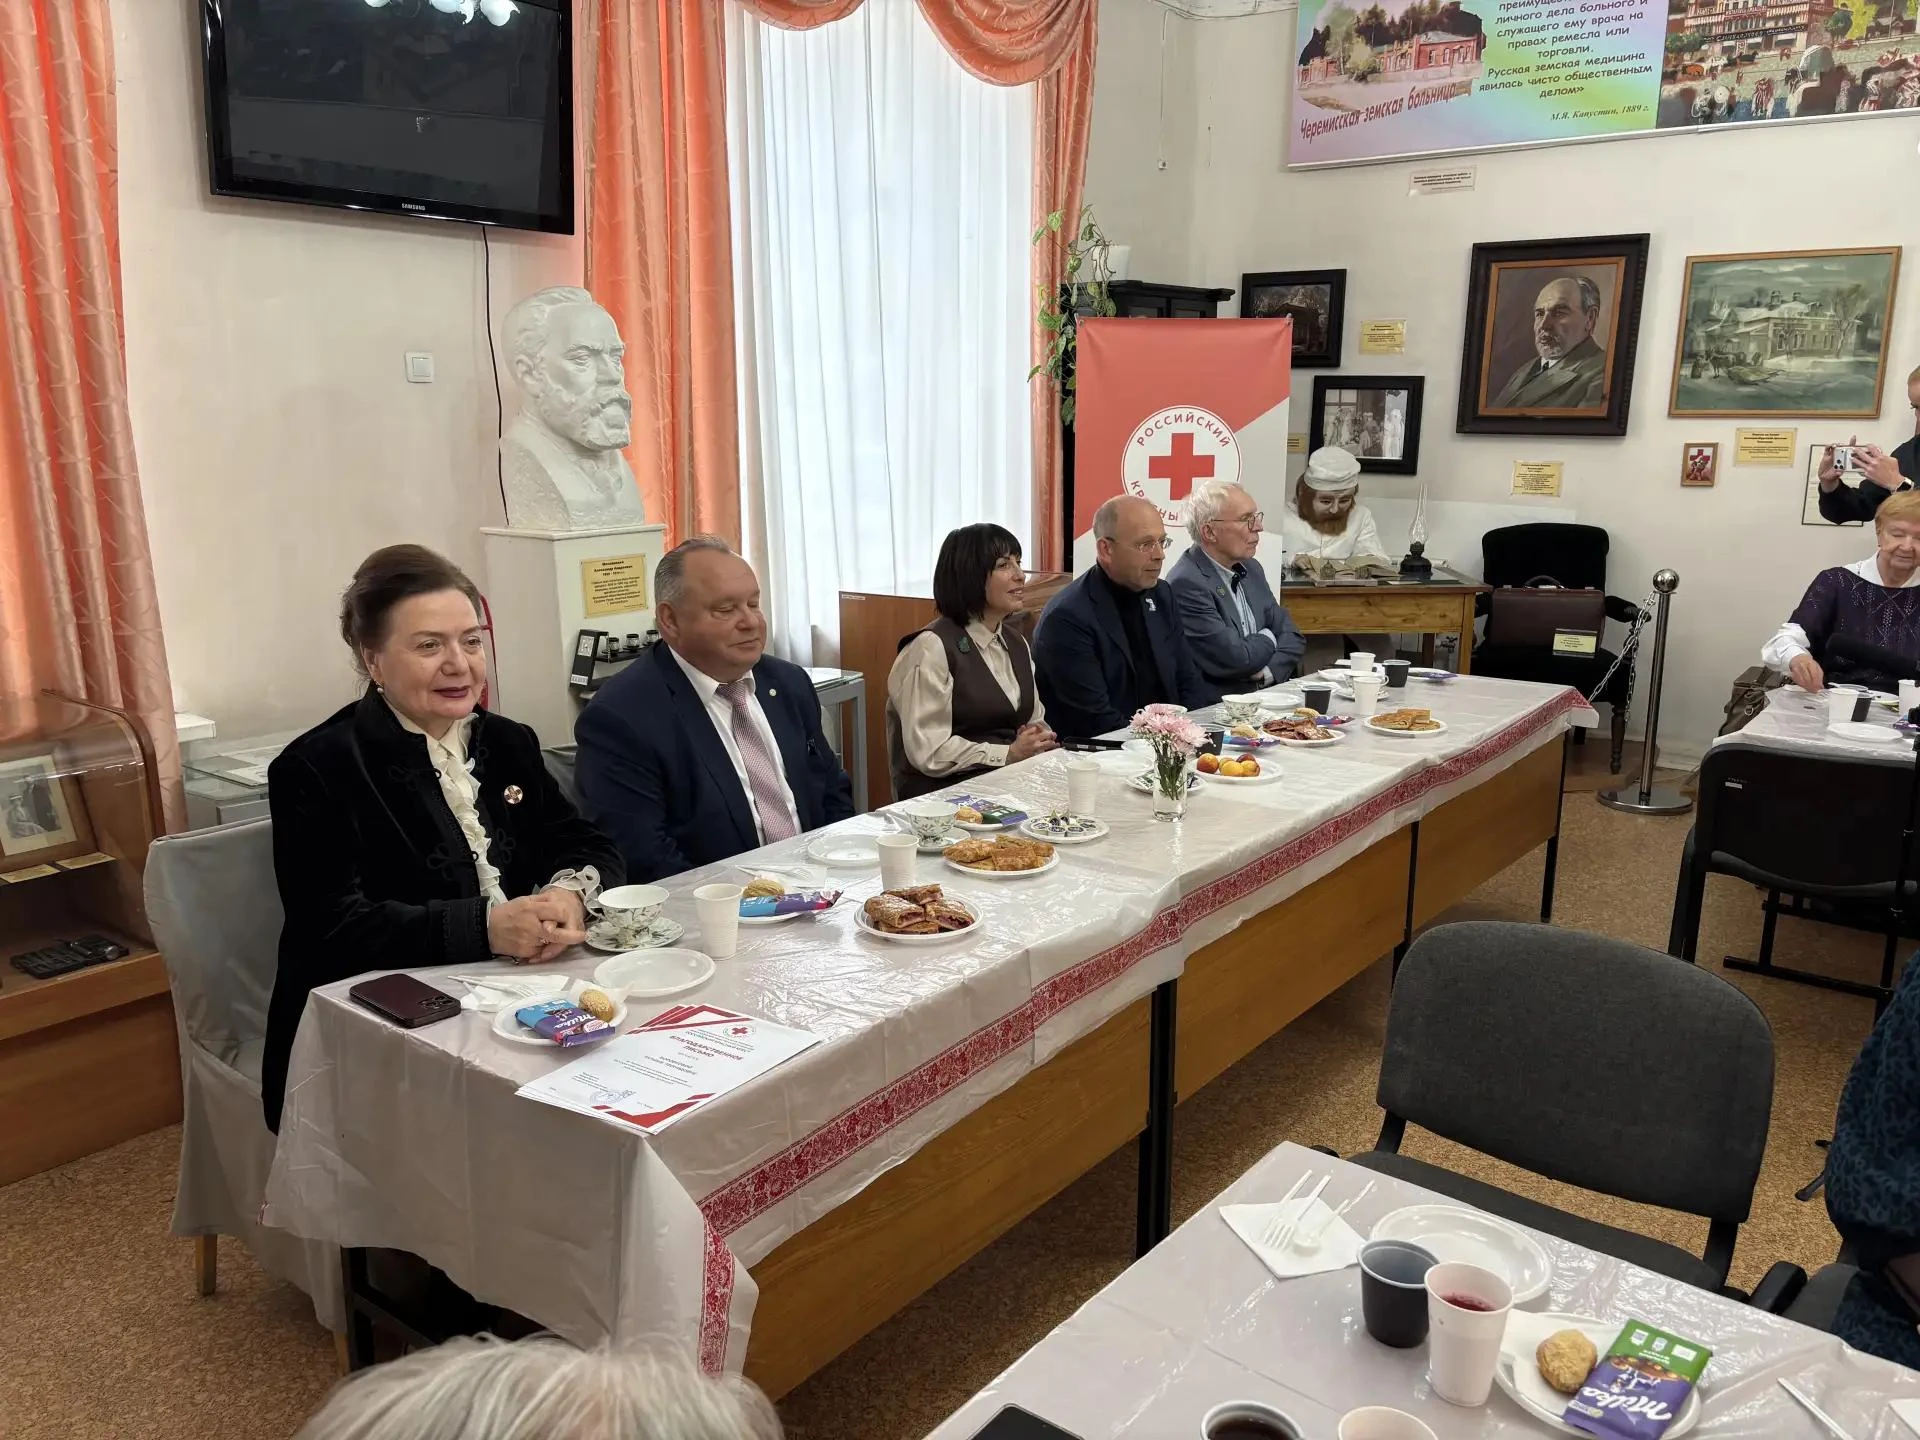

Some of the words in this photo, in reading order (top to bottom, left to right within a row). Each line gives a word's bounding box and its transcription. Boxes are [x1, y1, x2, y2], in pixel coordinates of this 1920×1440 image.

[1495, 12, 1542, 24] личного
[1547, 7, 1574, 18] дела
[1580, 0, 1635, 12] больного
[1497, 23, 1559, 38] служащего
[1564, 19, 1586, 29] ему
[1592, 14, 1624, 27] врача
[1629, 12, 1643, 20] на
[1508, 37, 1547, 50] правах
[1552, 31, 1600, 46] ремесла
[1606, 27, 1630, 37] или
[1538, 45, 1594, 59] торговли.
[1479, 81, 1523, 92] явилась
[1528, 76, 1560, 85] чисто
[1564, 65, 1653, 81] общественным
[1488, 66, 1530, 79] Русская
[1535, 60, 1580, 72] земская
[1585, 52, 1645, 66] медицина
[1539, 86, 1584, 98] делом»
[1300, 110, 1361, 144] Черемисская
[1363, 97, 1404, 123] земская
[1408, 83, 1457, 110] больница
[1622, 104, 1642, 114] 1889
[1137, 412, 1231, 447] РОССИЙСКИЙ
[1580, 1386, 1672, 1420] Milka
